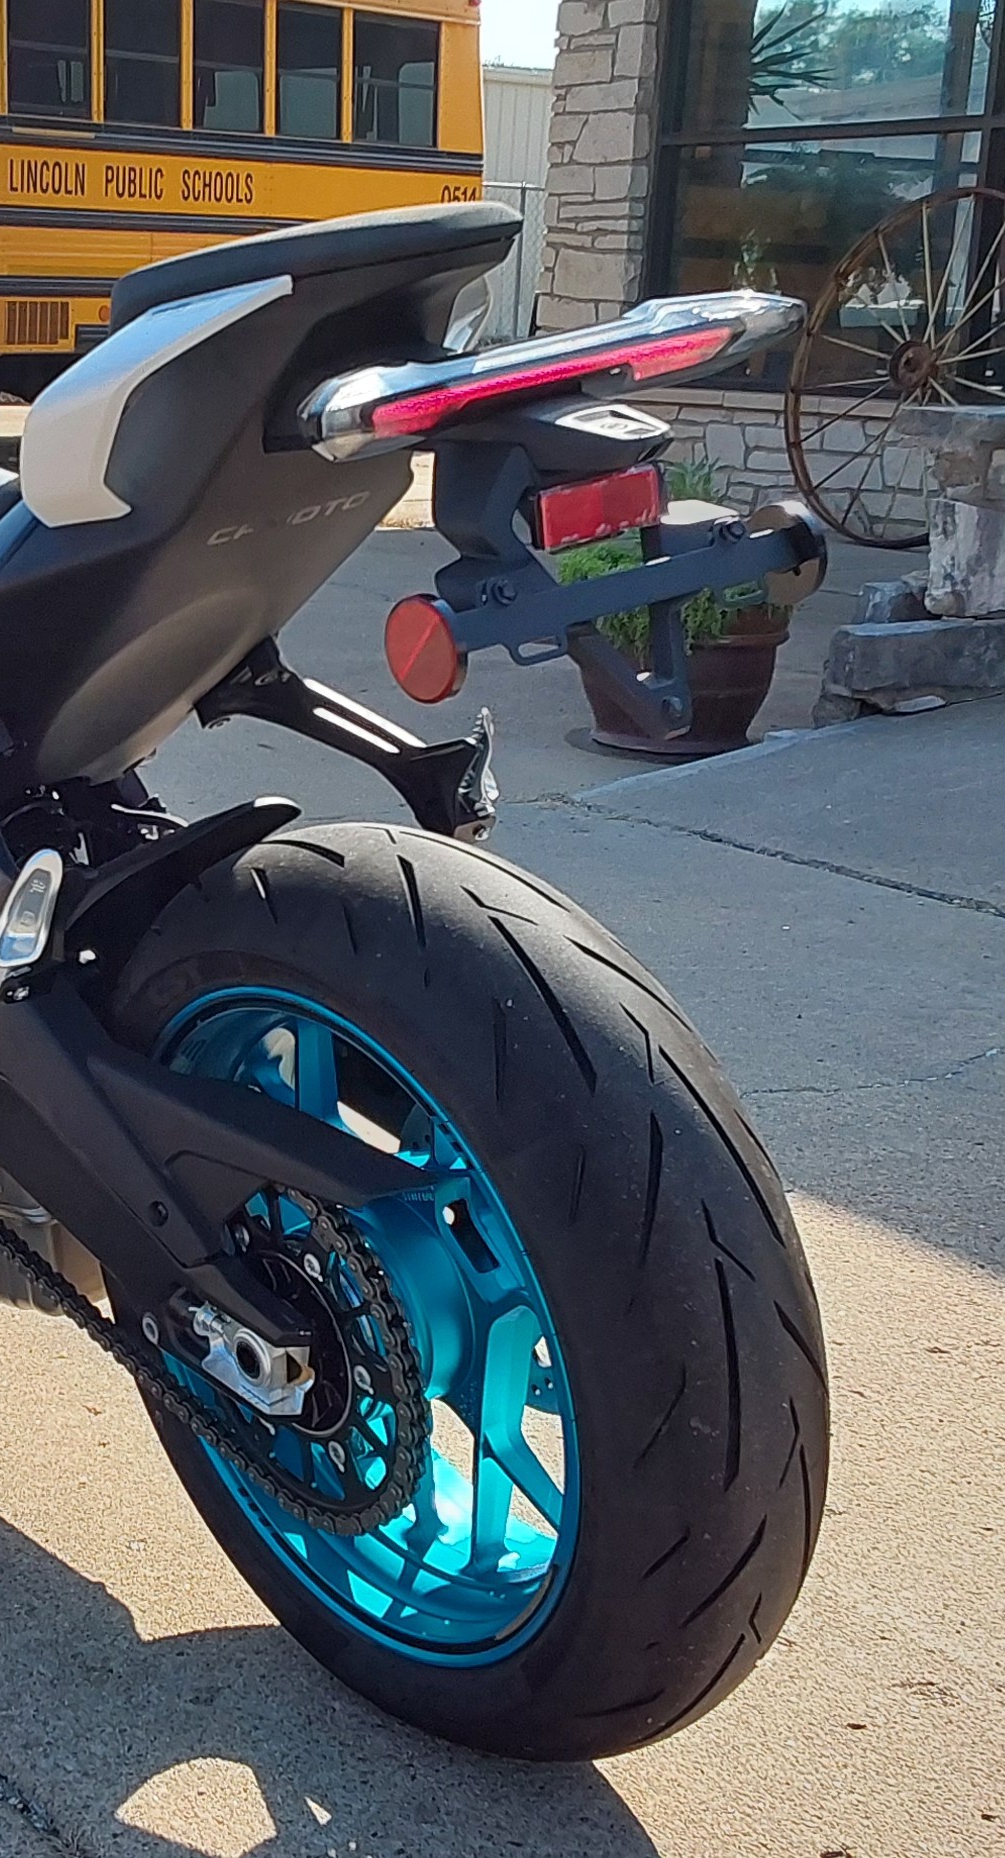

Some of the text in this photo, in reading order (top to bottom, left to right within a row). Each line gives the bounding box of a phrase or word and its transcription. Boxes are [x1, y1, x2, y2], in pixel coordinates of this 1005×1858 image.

[8, 158, 254, 205] LINCOLN PUBLIC SCHOOLS
